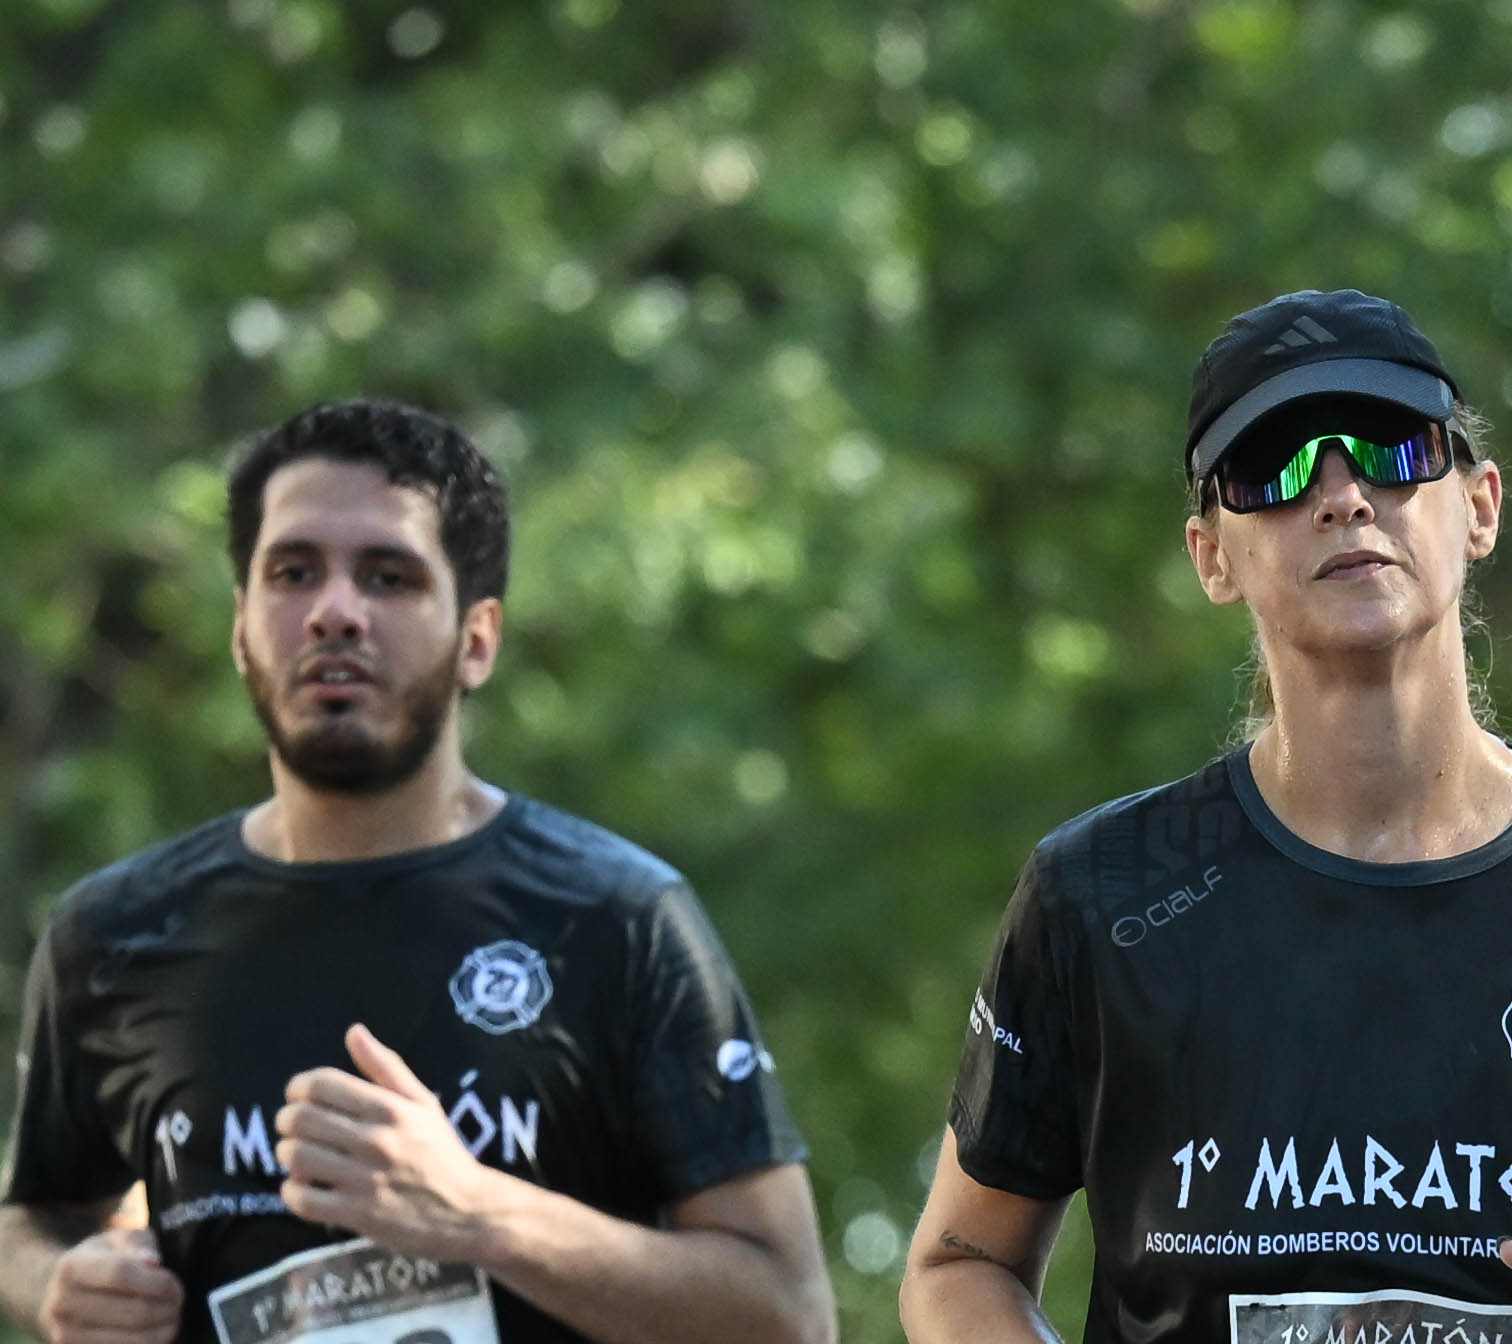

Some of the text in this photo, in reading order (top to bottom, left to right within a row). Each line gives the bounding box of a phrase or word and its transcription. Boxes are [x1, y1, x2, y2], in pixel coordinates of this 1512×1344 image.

[1145, 1229, 1499, 1258] ASOCIACIÓN BOMBEROS VOLUNTAR
